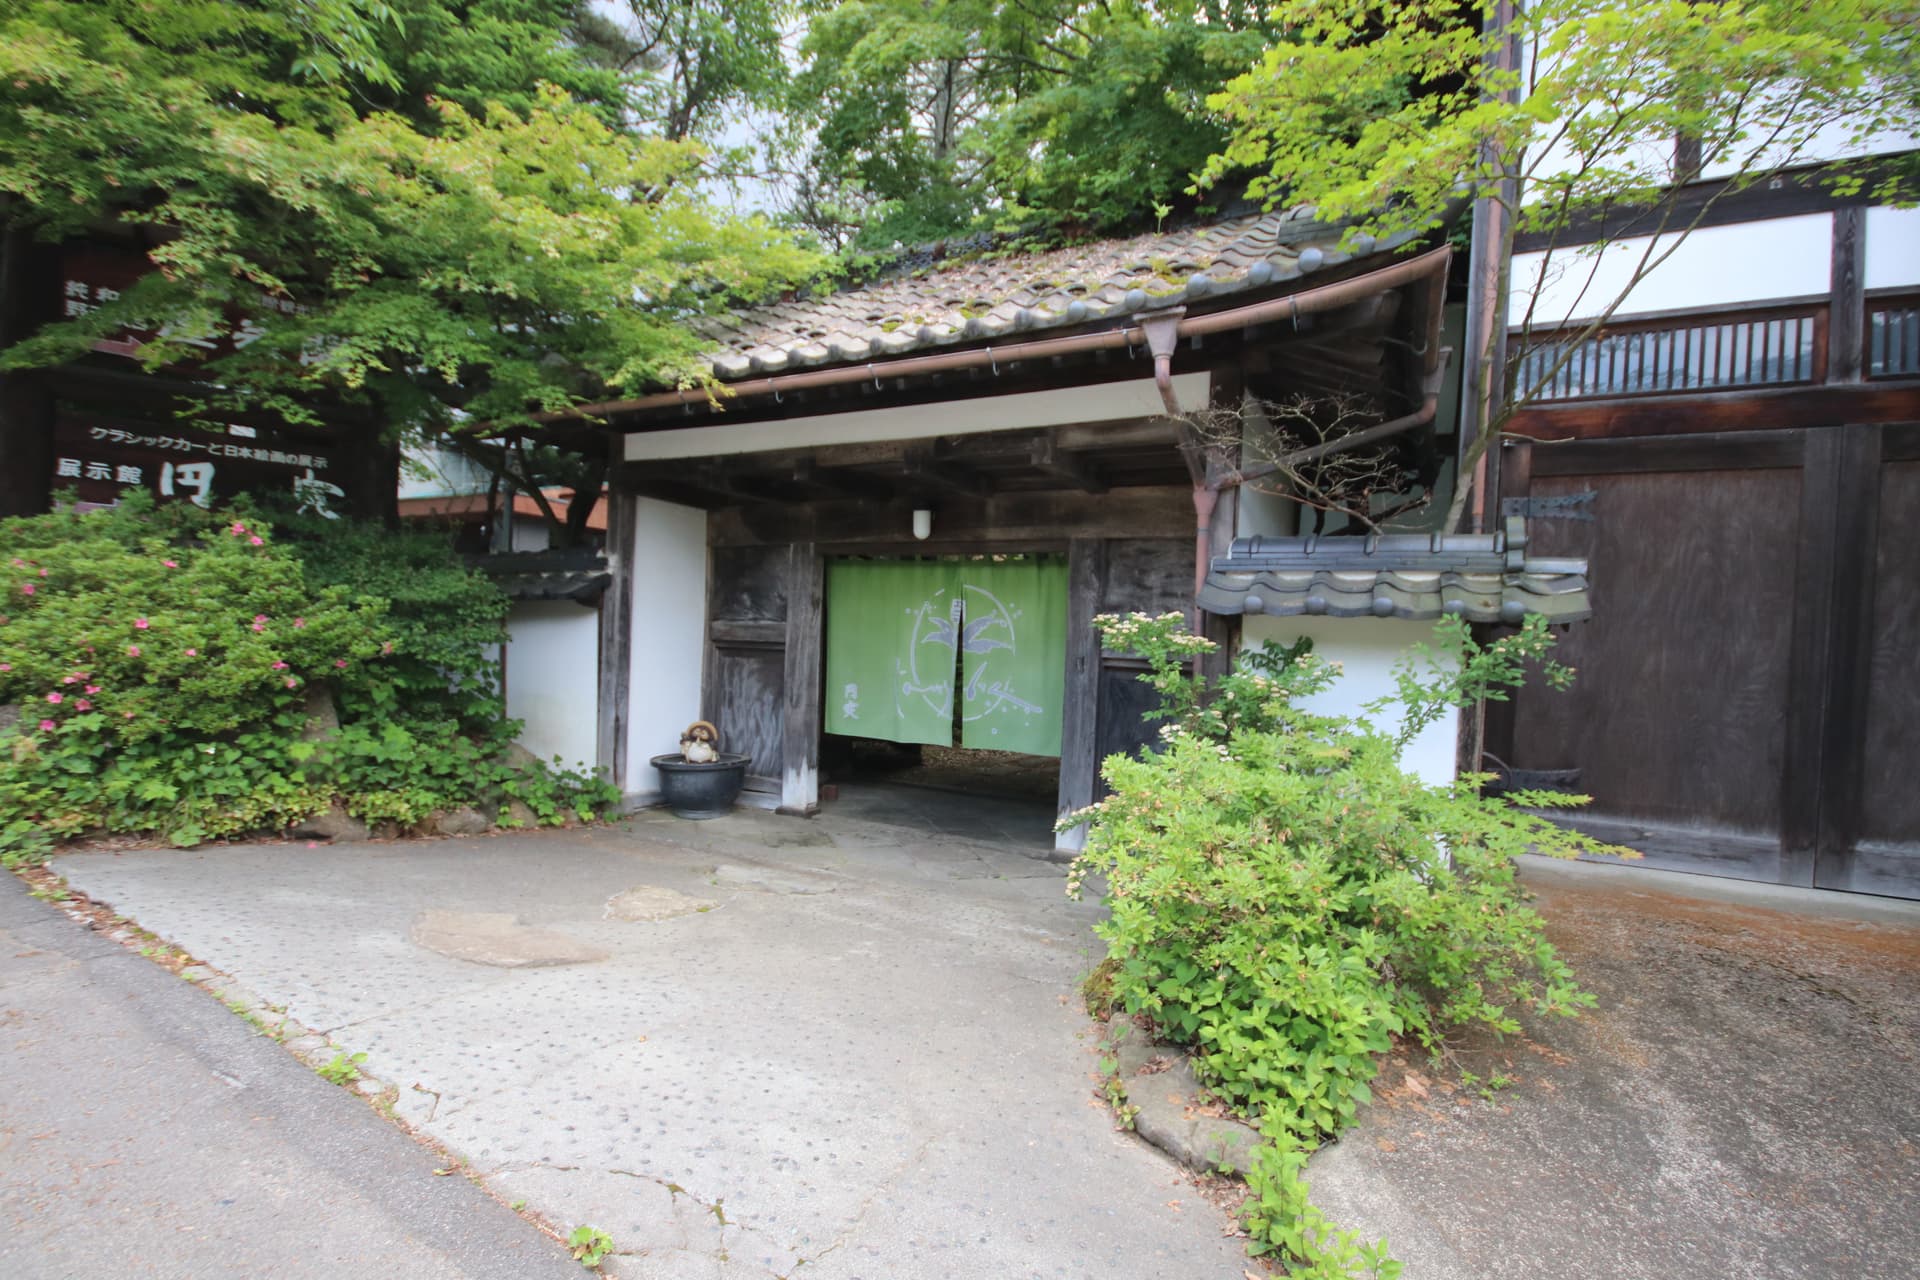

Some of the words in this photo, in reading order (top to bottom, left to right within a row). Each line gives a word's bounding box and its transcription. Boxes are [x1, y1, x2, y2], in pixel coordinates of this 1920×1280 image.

[90, 426, 328, 469] クラシックカーと日本絵画の展示
[58, 457, 143, 484] 展示館
